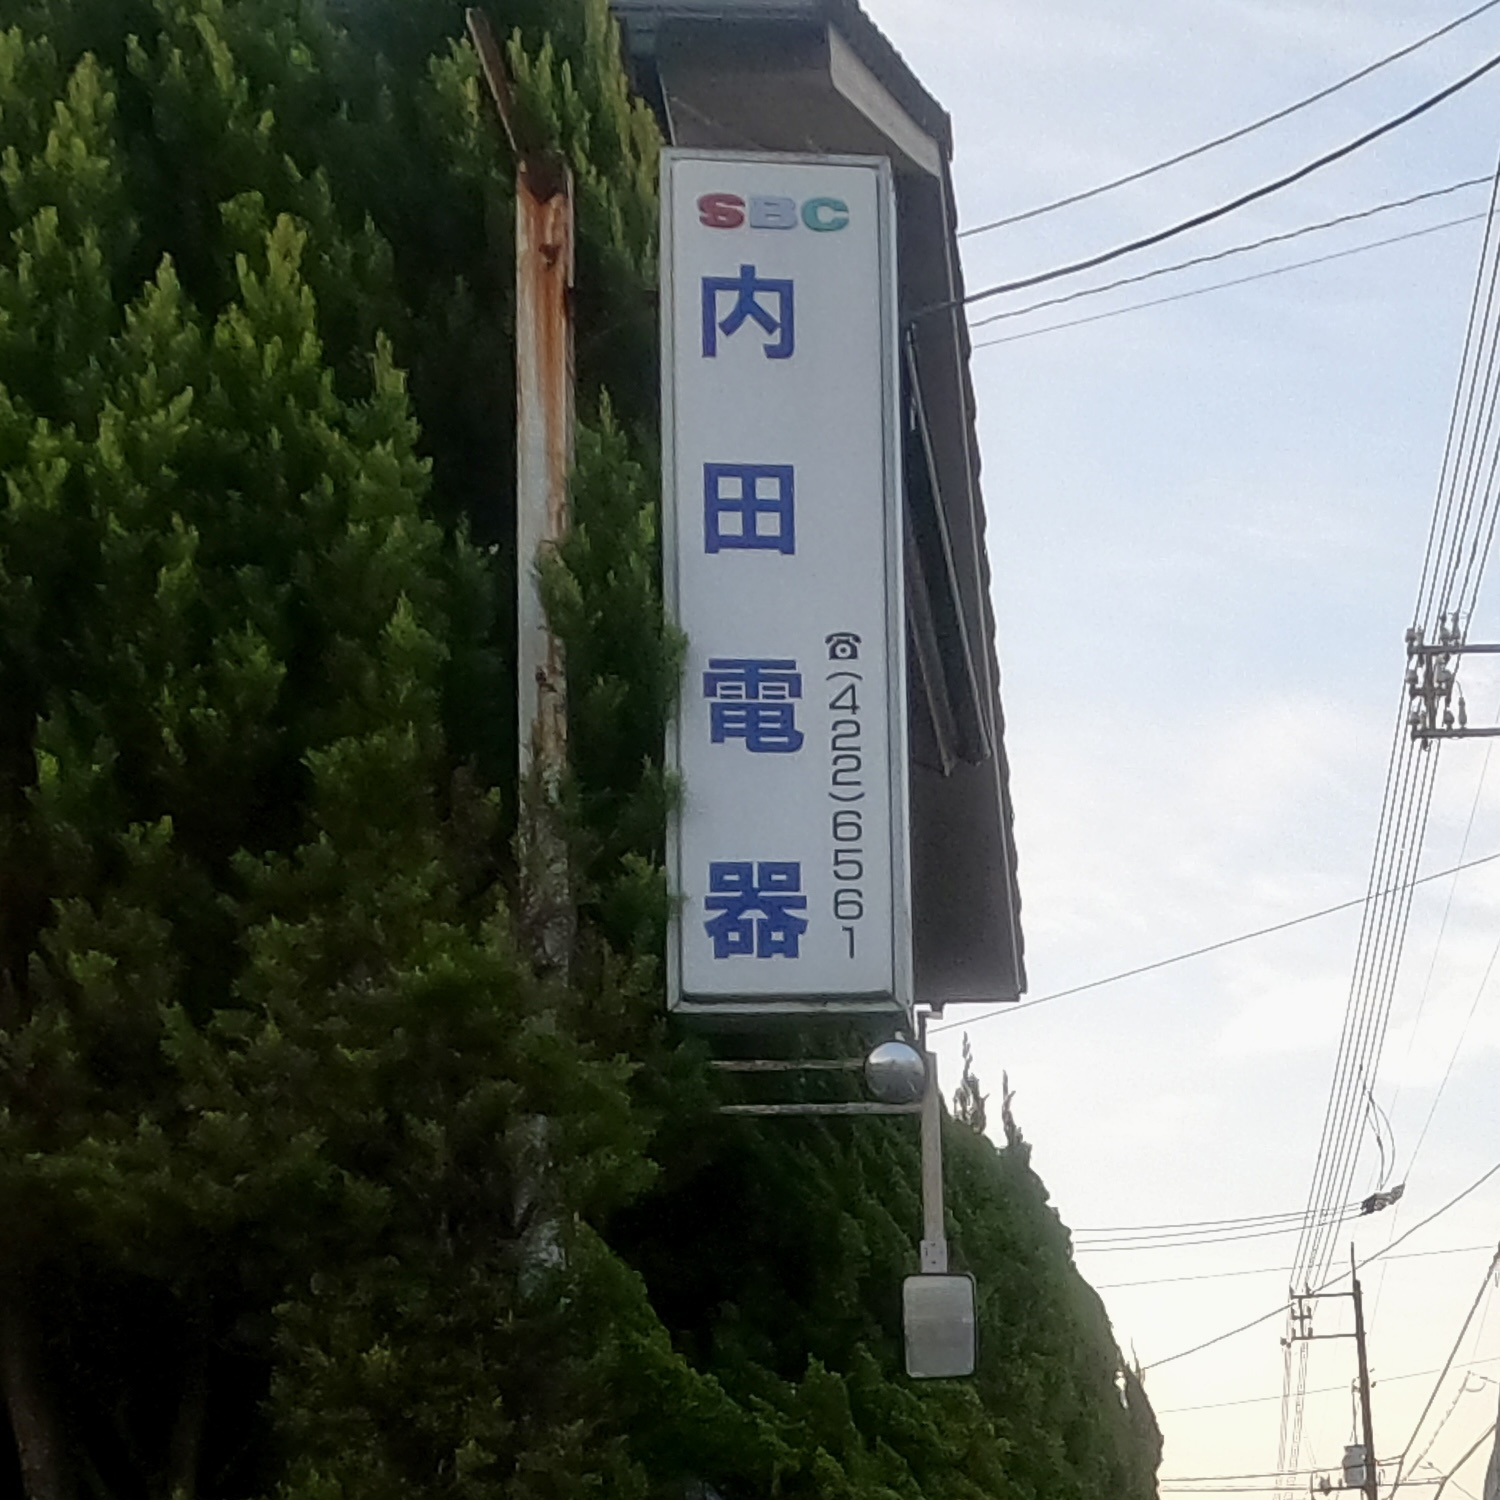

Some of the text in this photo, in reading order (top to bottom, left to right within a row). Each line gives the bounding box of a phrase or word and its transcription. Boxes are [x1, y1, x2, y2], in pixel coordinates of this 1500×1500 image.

[697, 193, 849, 232] SBC
[702, 264, 808, 959] 内田電器
[825, 672, 864, 959] (422)6561
